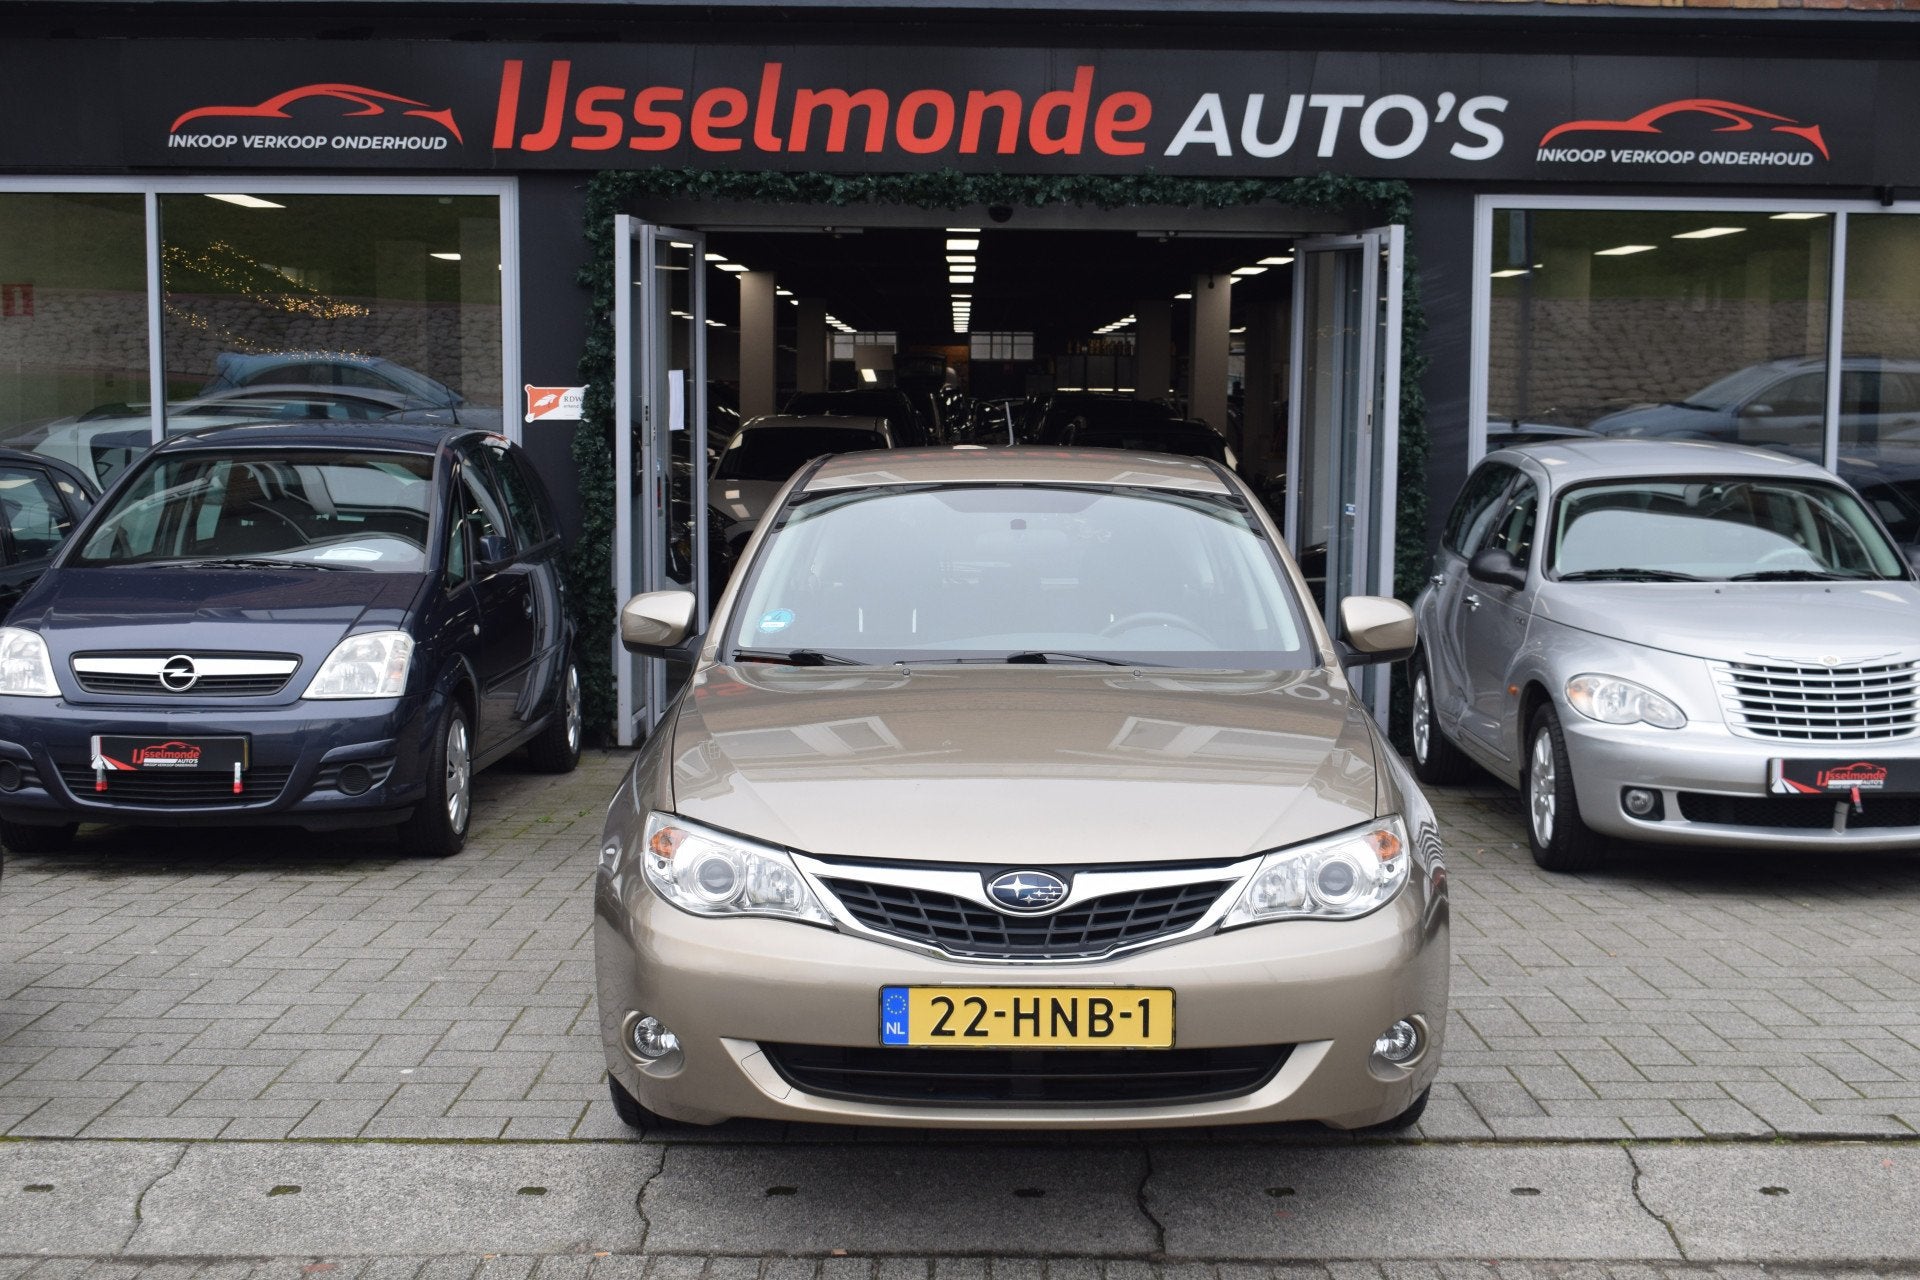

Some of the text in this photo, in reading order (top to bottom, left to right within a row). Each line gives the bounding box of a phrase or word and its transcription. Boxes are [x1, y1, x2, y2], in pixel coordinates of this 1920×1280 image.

[492, 60, 1510, 161] IJsselmonde AUTO'S
[168, 134, 448, 150] INKOOP VERKOOP ONDERHOUD
[1536, 148, 1814, 166] INKOOP VERKOOP ONDERHOUD
[133, 748, 199, 764] IJsselmonde
[1817, 771, 1886, 786] IJsselmonde
[930, 996, 1150, 1038] 22-HNB-1
[886, 1022, 905, 1035] NL
